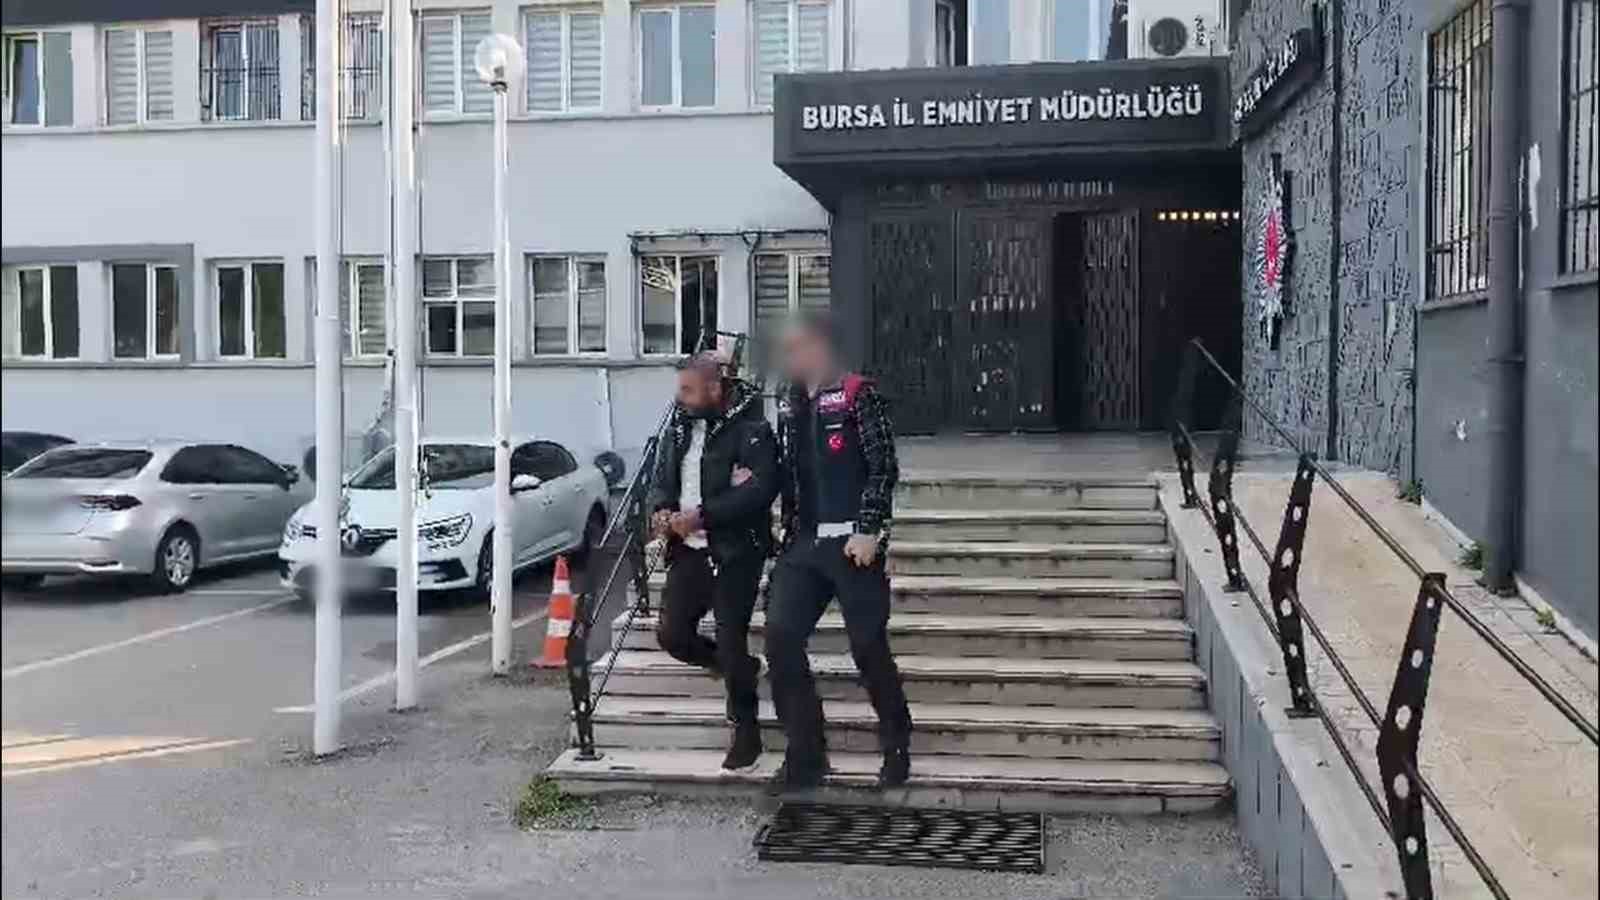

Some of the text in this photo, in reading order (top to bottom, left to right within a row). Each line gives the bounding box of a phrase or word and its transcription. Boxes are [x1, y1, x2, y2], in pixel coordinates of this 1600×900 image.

[802, 85, 1202, 129] BURSA İL EMNİYET MÜDÜRLÜĞÜ
